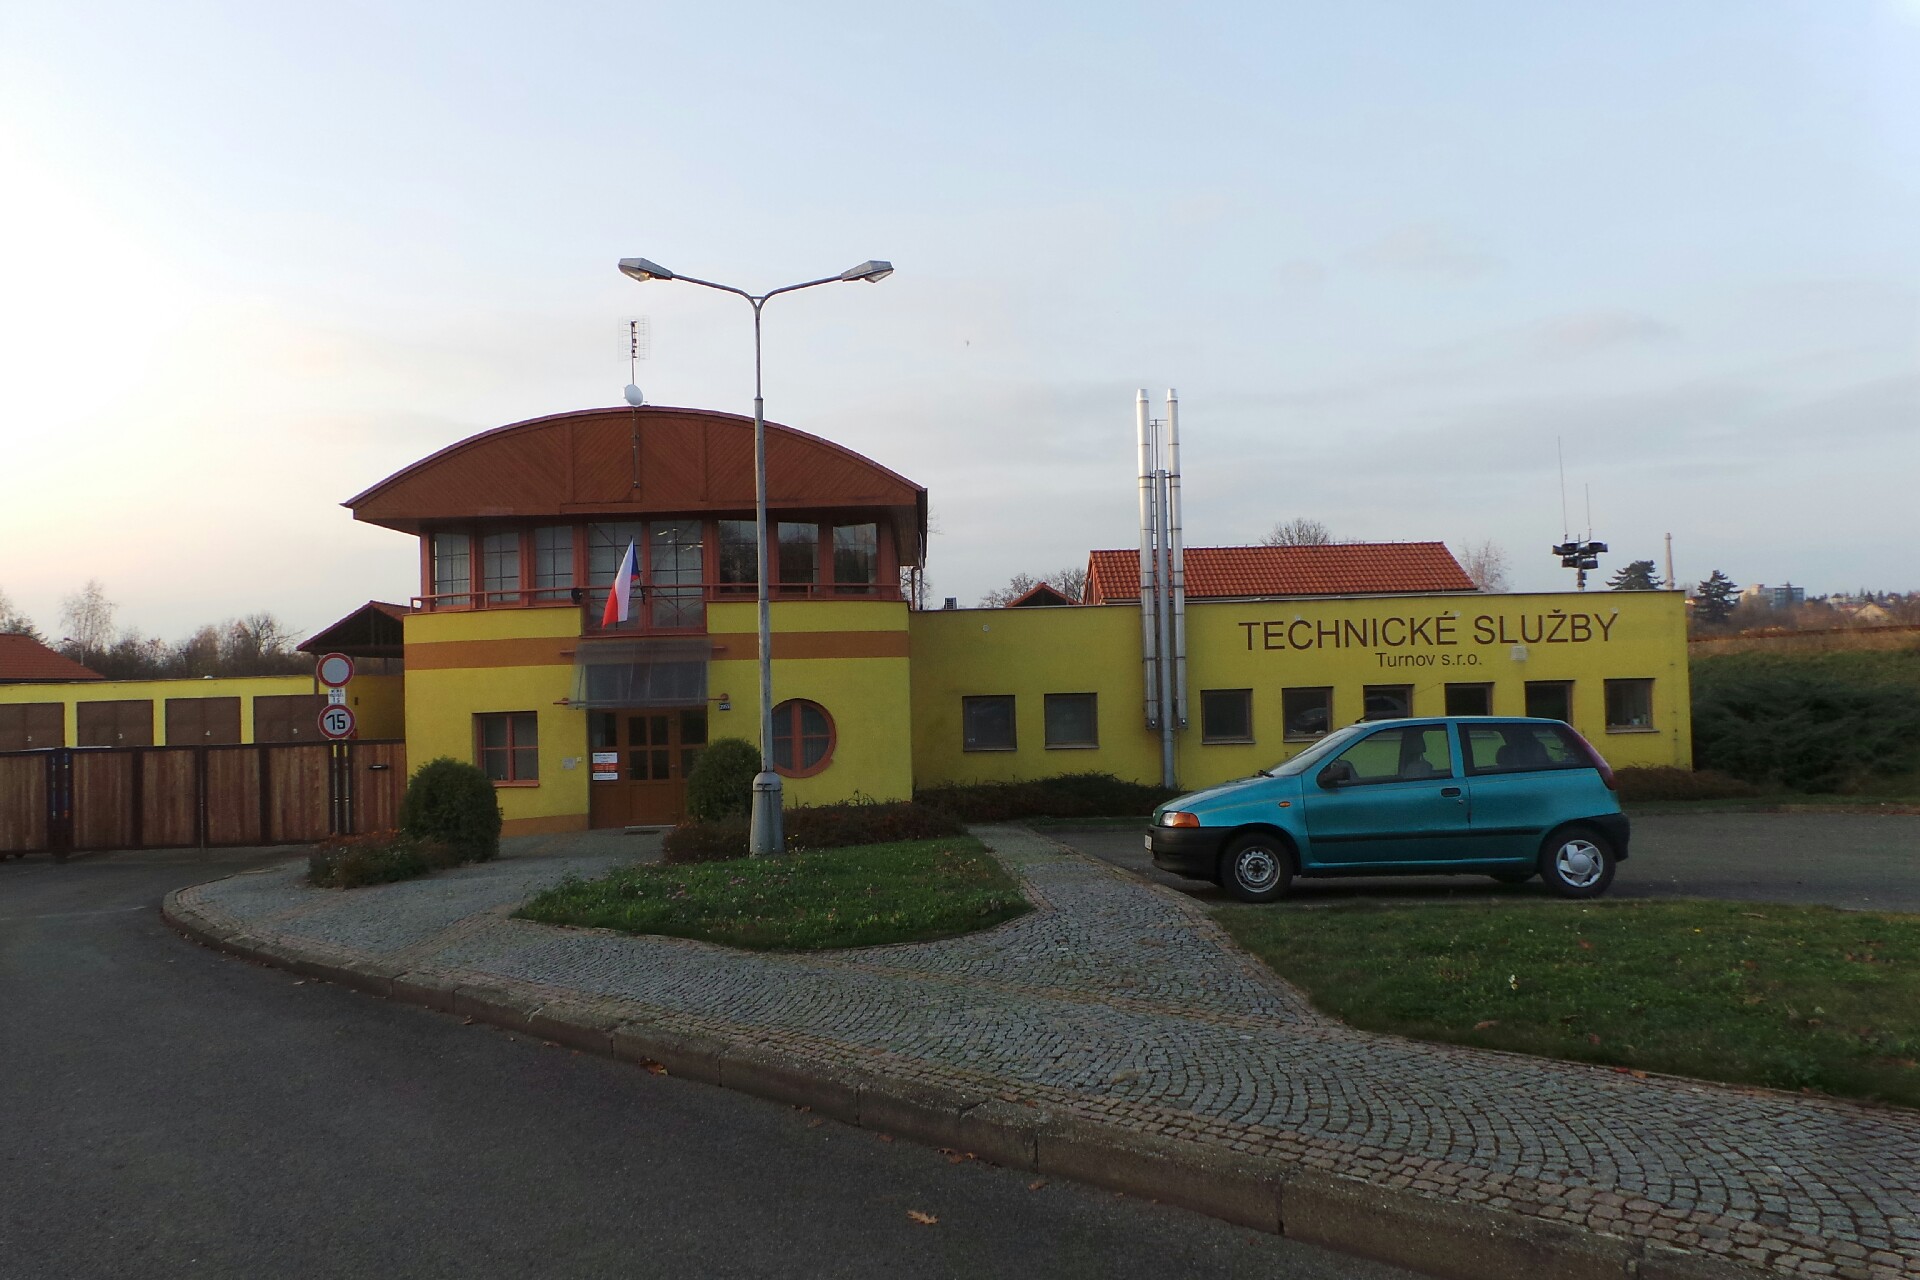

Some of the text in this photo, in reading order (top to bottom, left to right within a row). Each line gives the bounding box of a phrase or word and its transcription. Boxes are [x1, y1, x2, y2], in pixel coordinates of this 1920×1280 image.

[1238, 609, 1619, 651] TECHNICKÉ SLUŽBY
[1375, 651, 1482, 668] Turnov s.r.o.
[326, 714, 346, 730] 15
